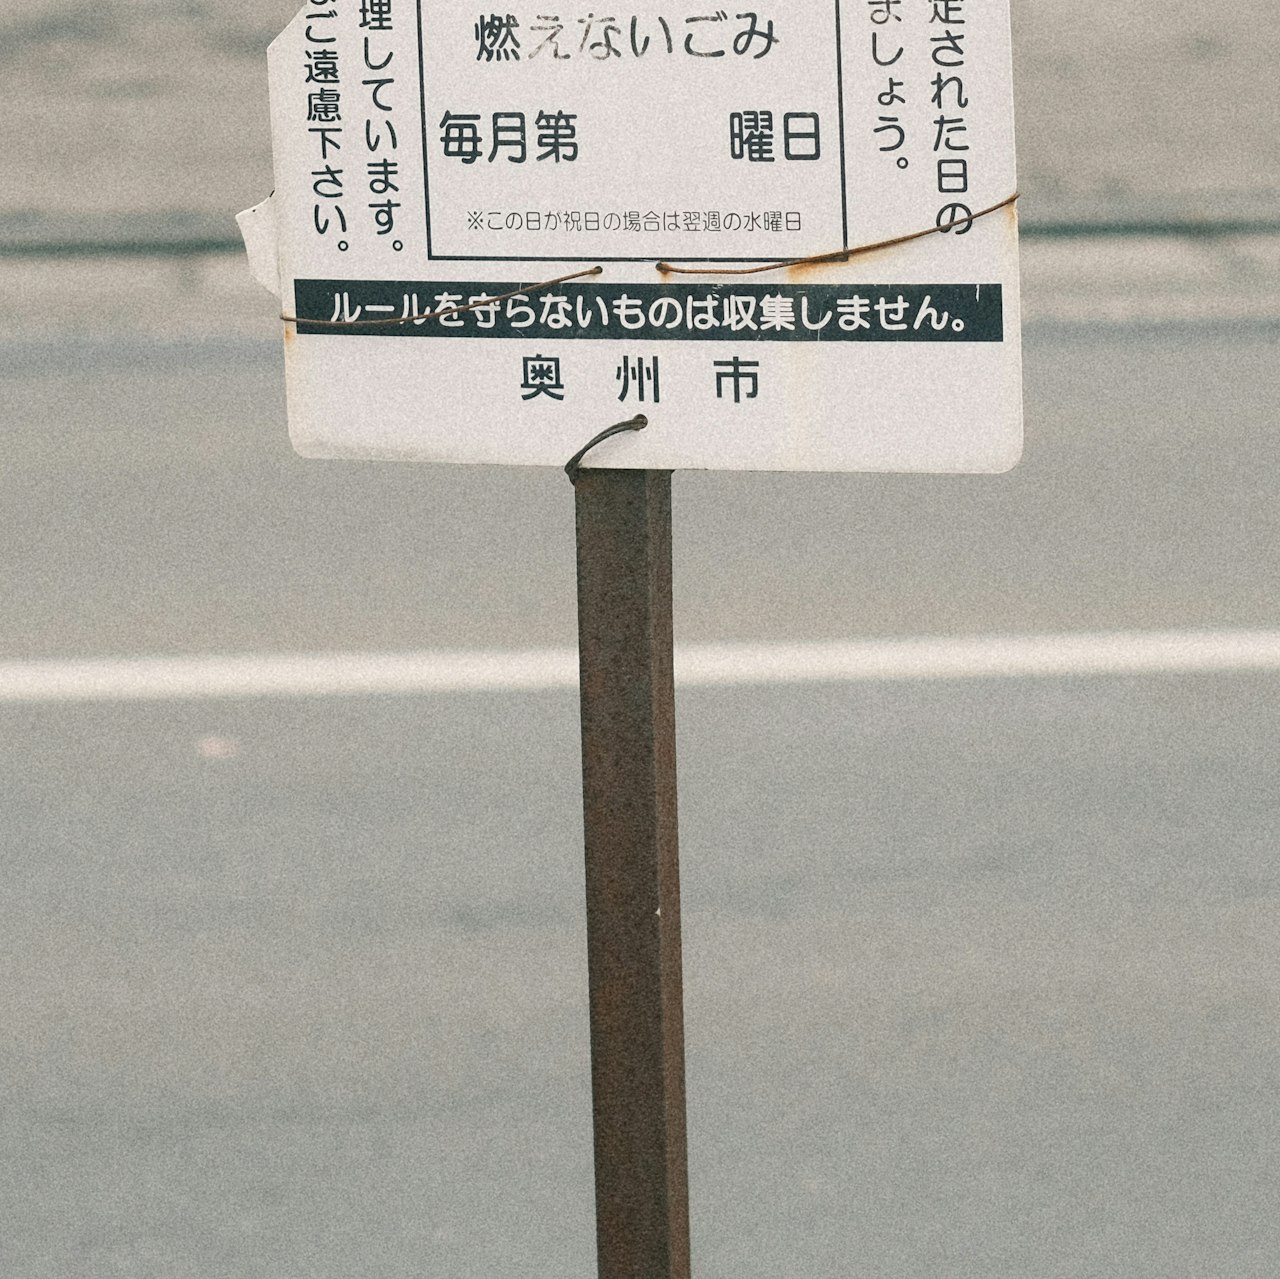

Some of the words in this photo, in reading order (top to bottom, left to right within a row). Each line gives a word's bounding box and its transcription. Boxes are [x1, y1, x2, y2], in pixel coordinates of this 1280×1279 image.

[474, 10, 780, 62] 燃えないごみ
[439, 109, 579, 164] 毎月第
[729, 109, 821, 163] 曜日
[466, 210, 803, 233] ※この日が祝日の場合は翌週の水曜日
[330, 292, 967, 334] ルールを守らないものは収集しません。
